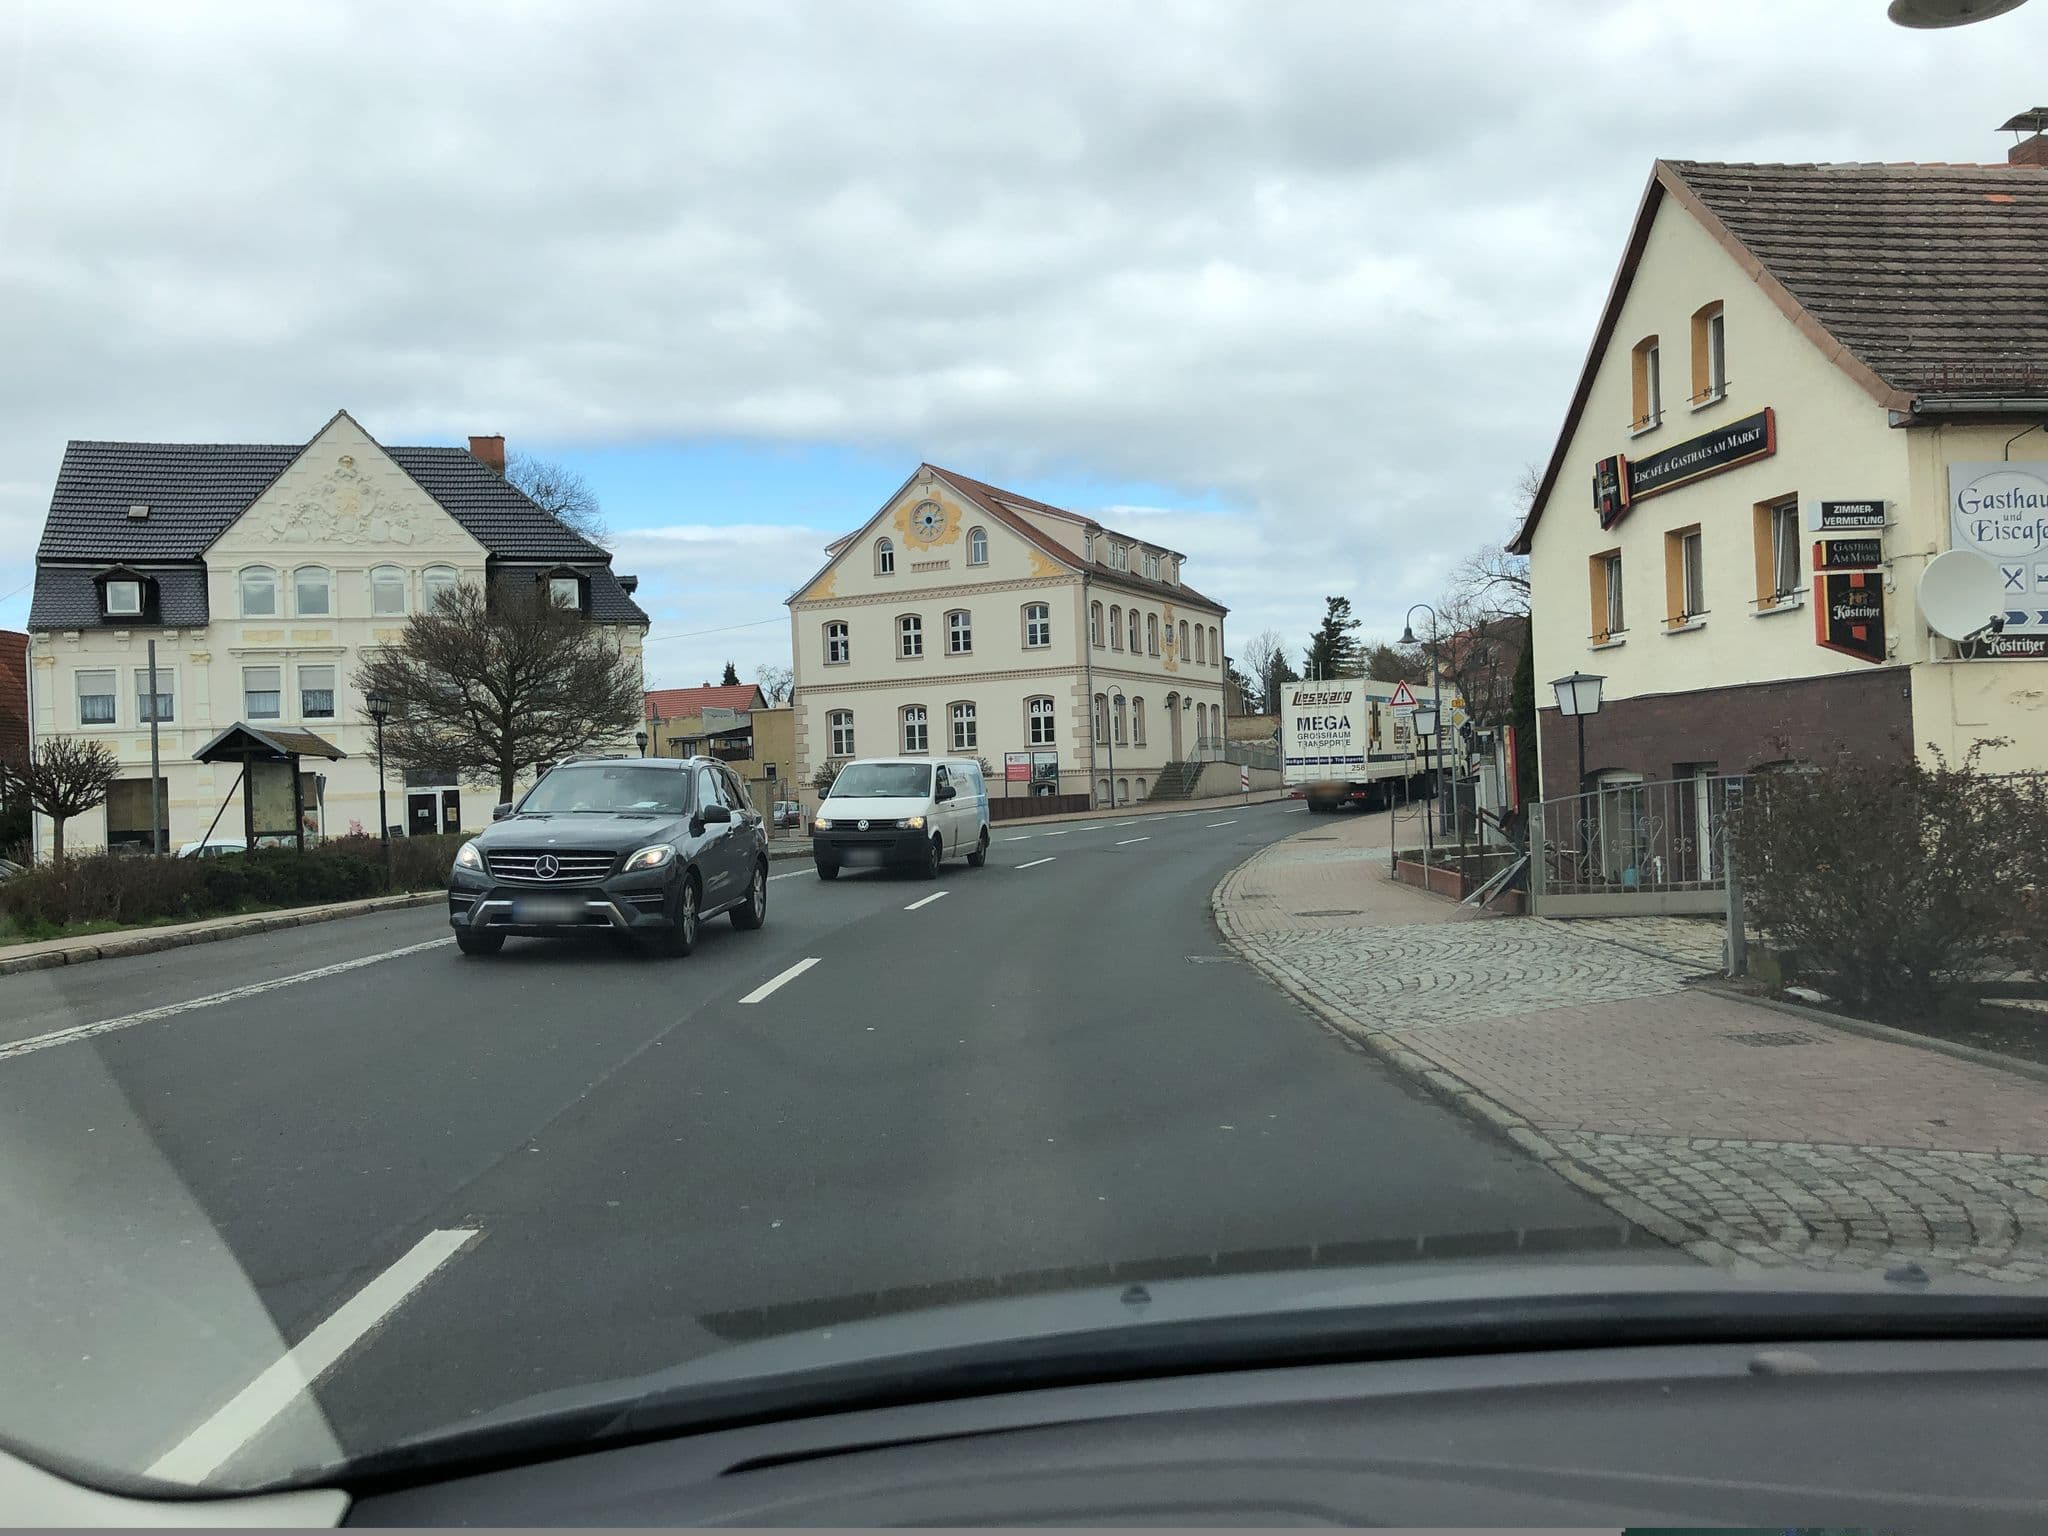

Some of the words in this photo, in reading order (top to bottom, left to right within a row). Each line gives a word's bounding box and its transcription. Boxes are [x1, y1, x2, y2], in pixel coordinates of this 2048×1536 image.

[1663, 464, 1670, 473] &
[1670, 444, 1712, 471] GASTHAUS
[1711, 442, 1726, 456] AM
[1727, 428, 1761, 450] MARKT
[1833, 504, 1874, 514] ZIMMER-
[1823, 515, 1885, 526] VERMIETUNG
[2003, 511, 2022, 522] und
[1832, 543, 1879, 552] GASTHAUS
[1832, 554, 1849, 563] AM
[1850, 552, 1880, 562] MARKT
[1833, 605, 1881, 620] Köstritzer
[1987, 638, 2046, 655] Köstritzer
[1296, 715, 1351, 731] MEGA
